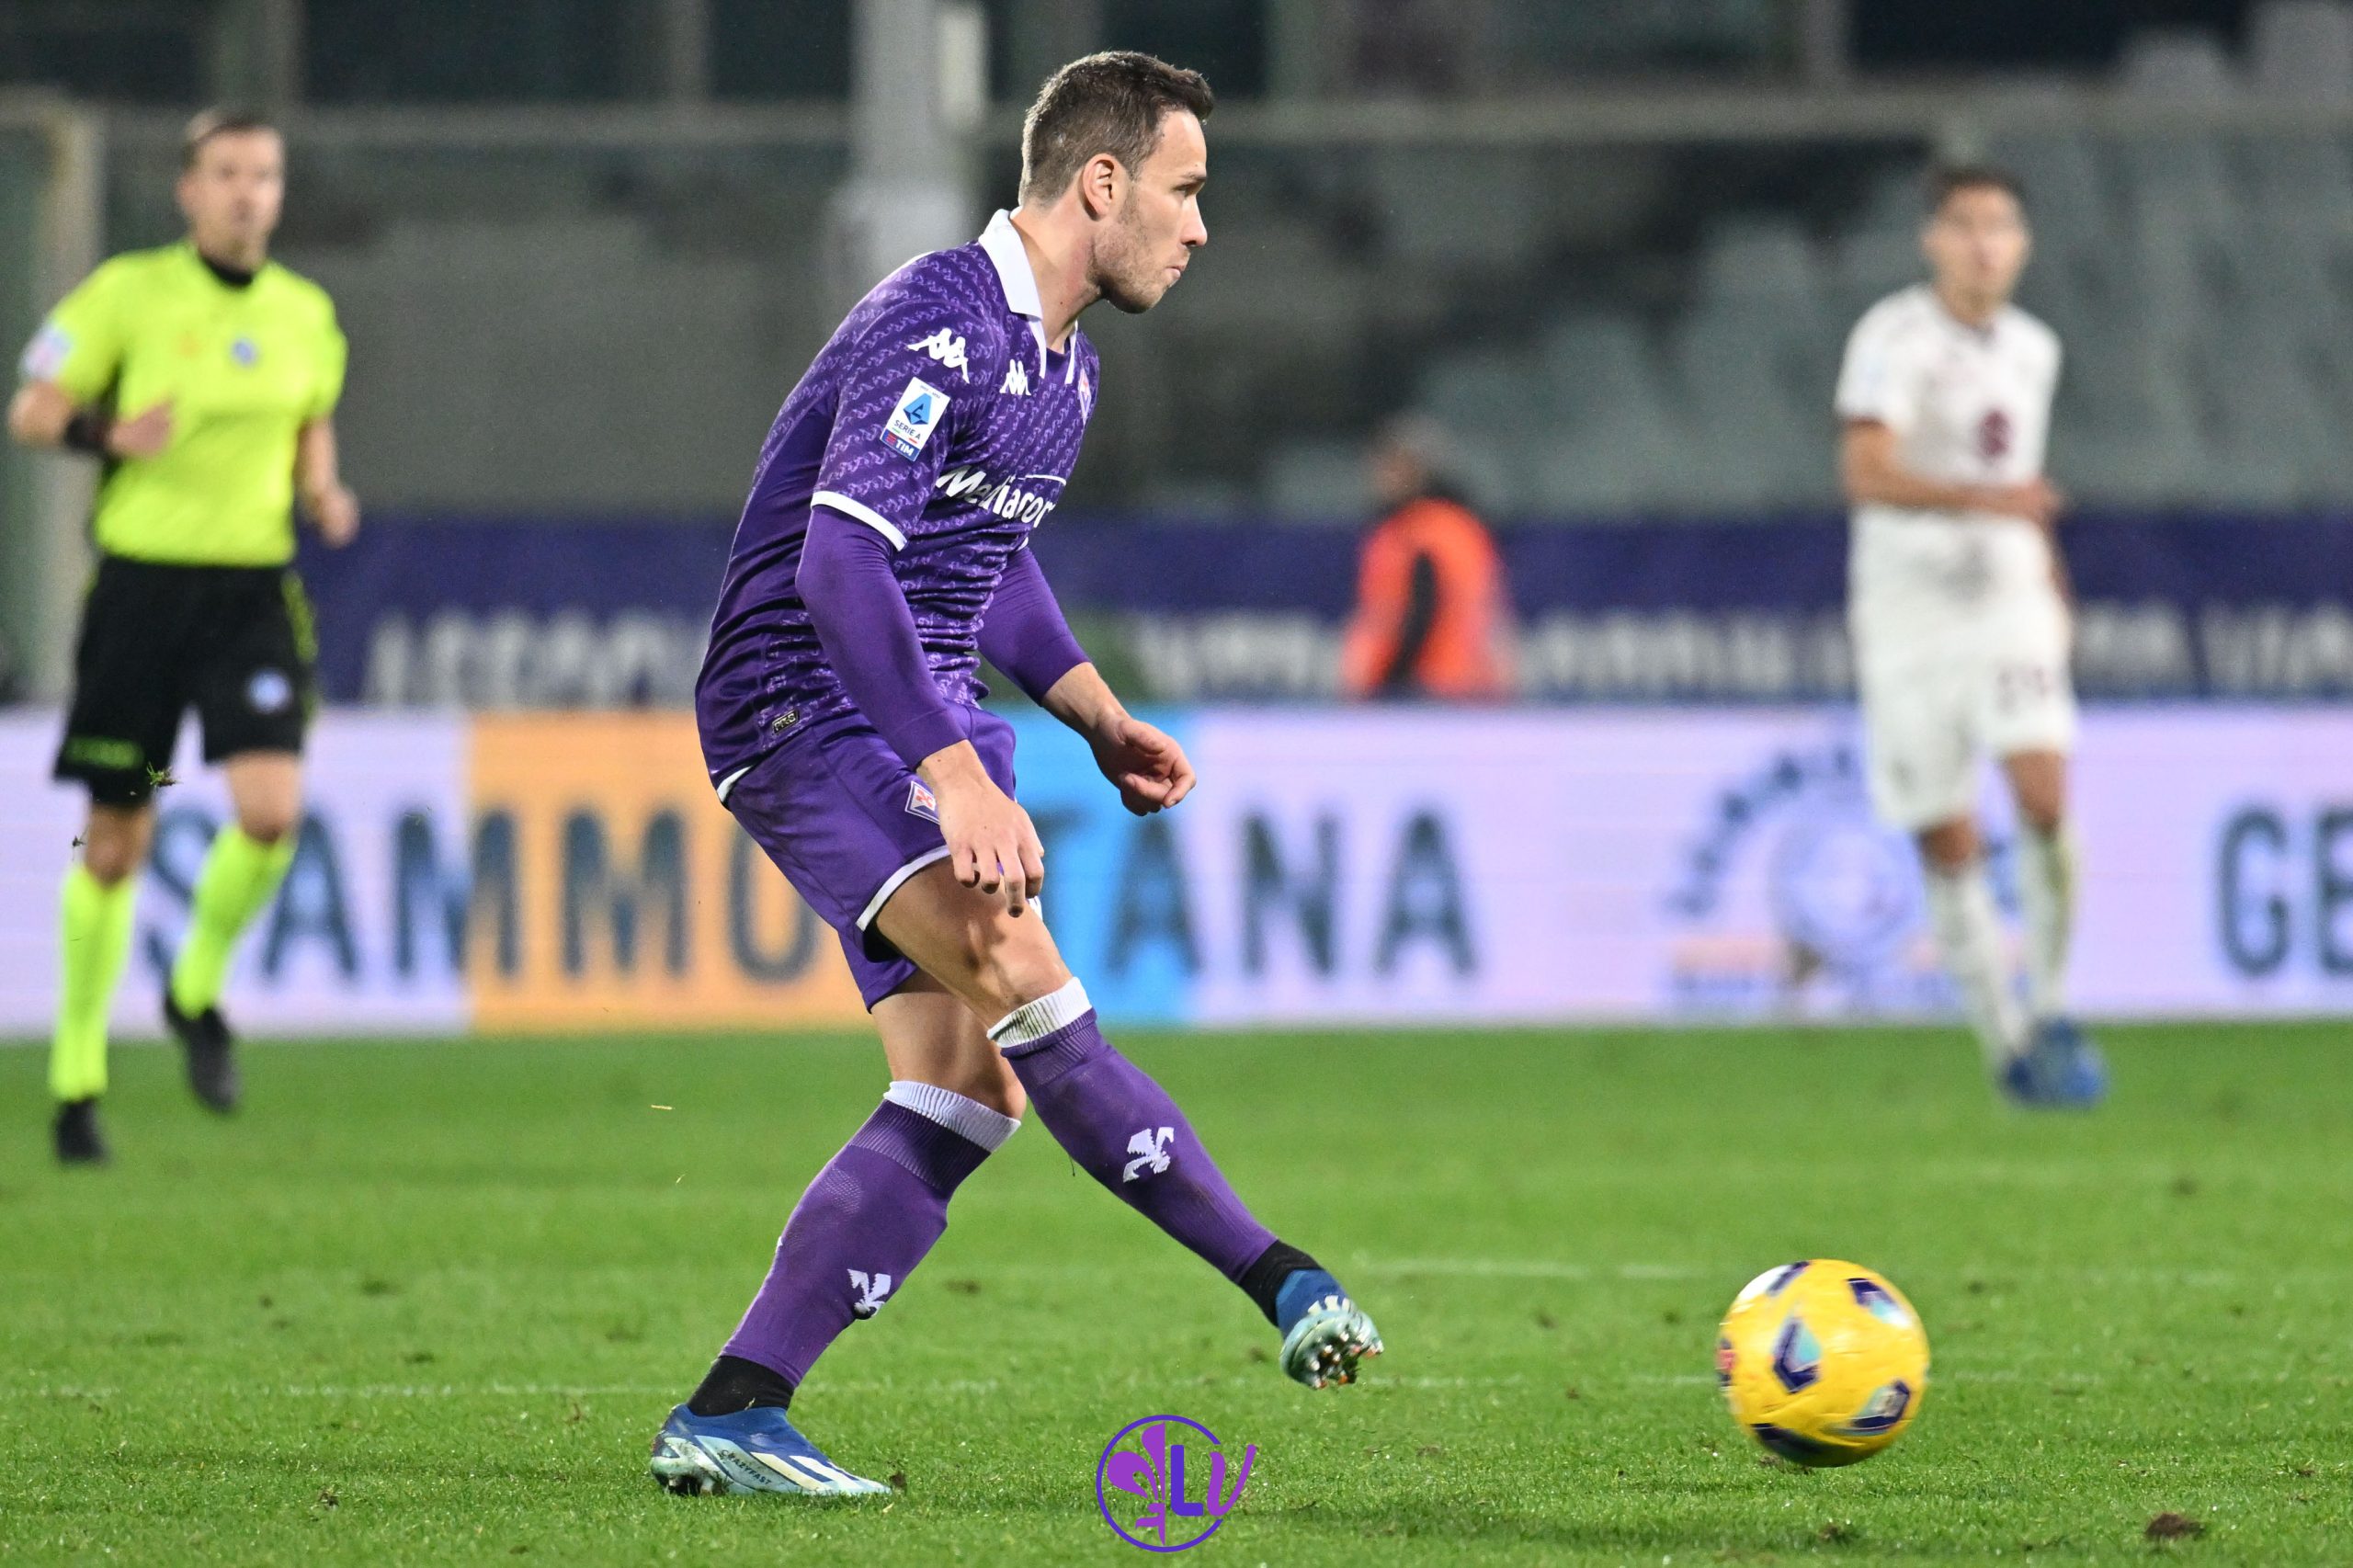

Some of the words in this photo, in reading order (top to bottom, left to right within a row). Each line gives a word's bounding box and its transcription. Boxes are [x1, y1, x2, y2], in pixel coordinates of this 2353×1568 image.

[894, 420, 915, 436] SERIE
[895, 438, 915, 456] TIM
[721, 1449, 772, 1485] CRAZYFAST
